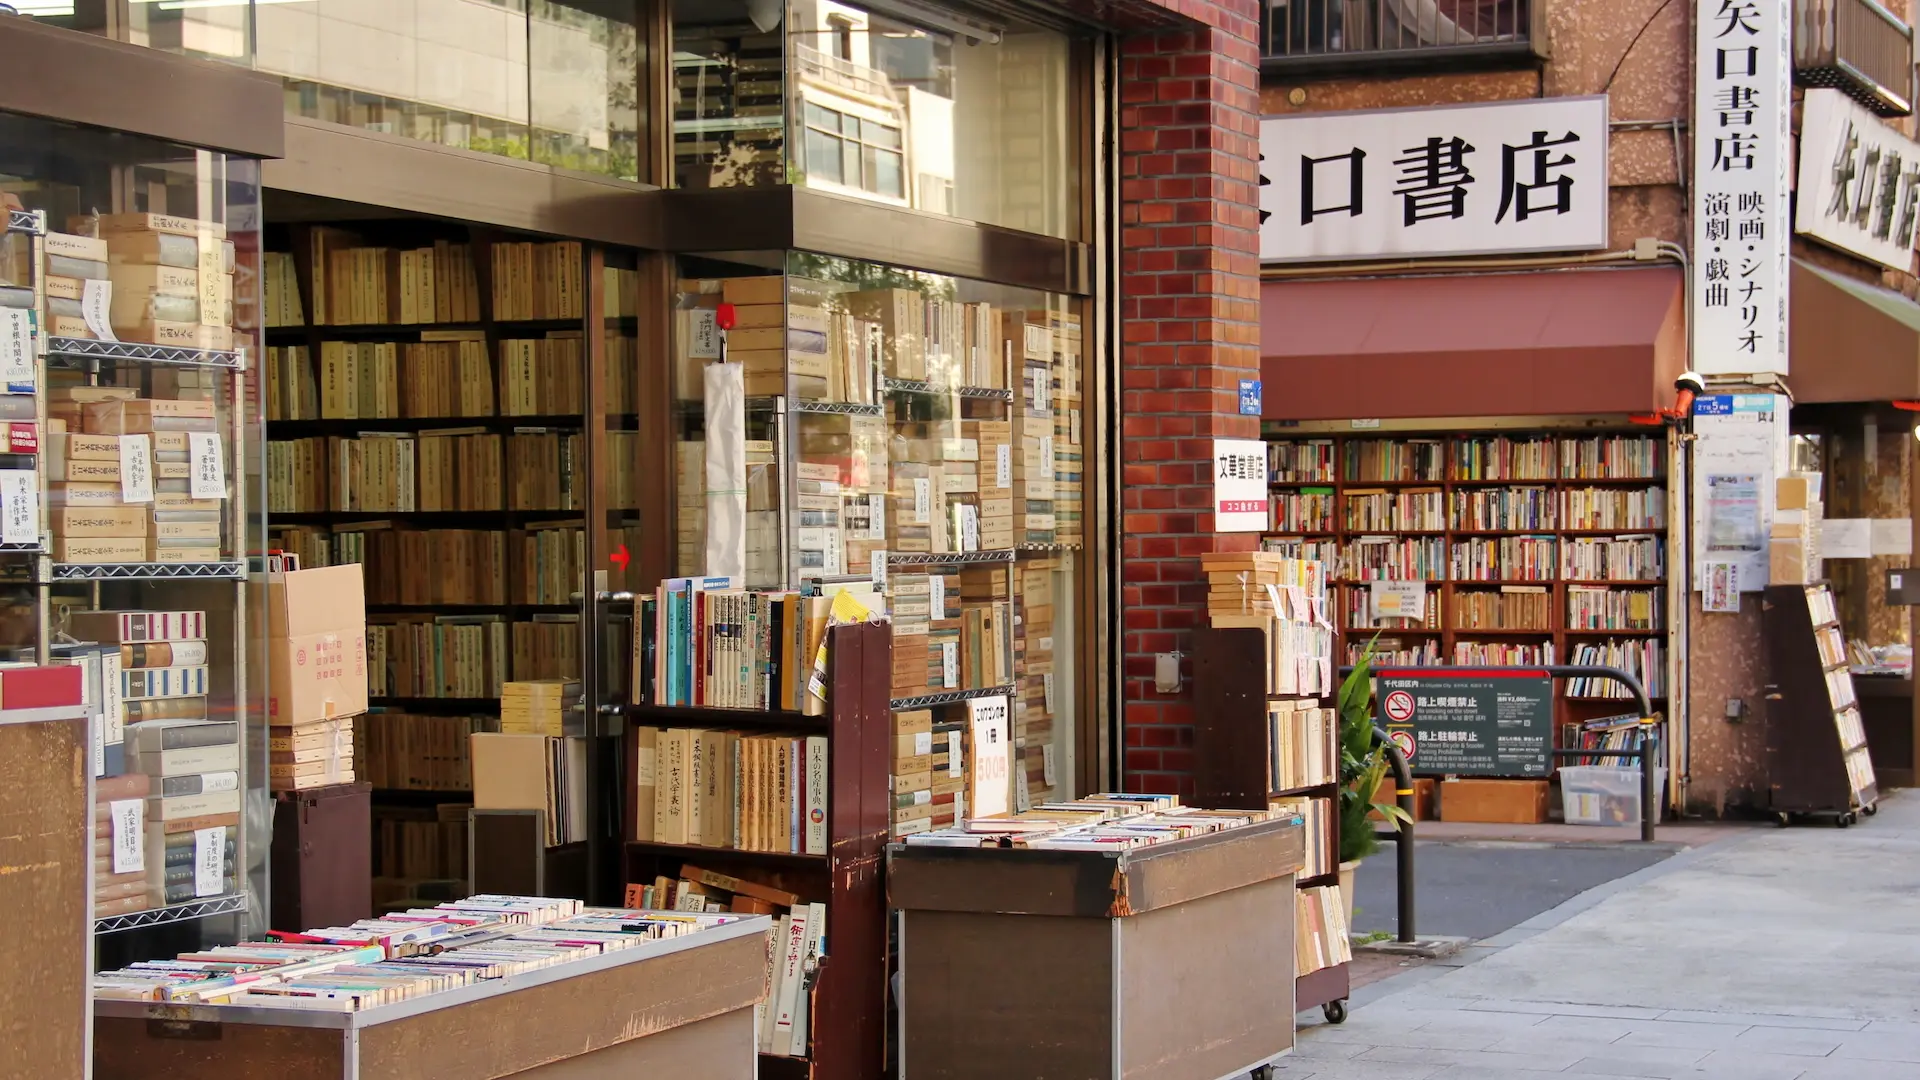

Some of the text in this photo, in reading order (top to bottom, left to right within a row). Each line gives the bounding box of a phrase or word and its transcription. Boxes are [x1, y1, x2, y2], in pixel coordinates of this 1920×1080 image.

[1712, 0, 1760, 172] 矢口書店
[1704, 191, 1730, 308] 演劇・戯曲
[1738, 191, 1766, 354] 映画・シナリオ
[1219, 453, 1263, 480] 文華堂書店
[812, 745, 822, 806] 日本の名産事典
[977, 755, 1006, 781] 500円
